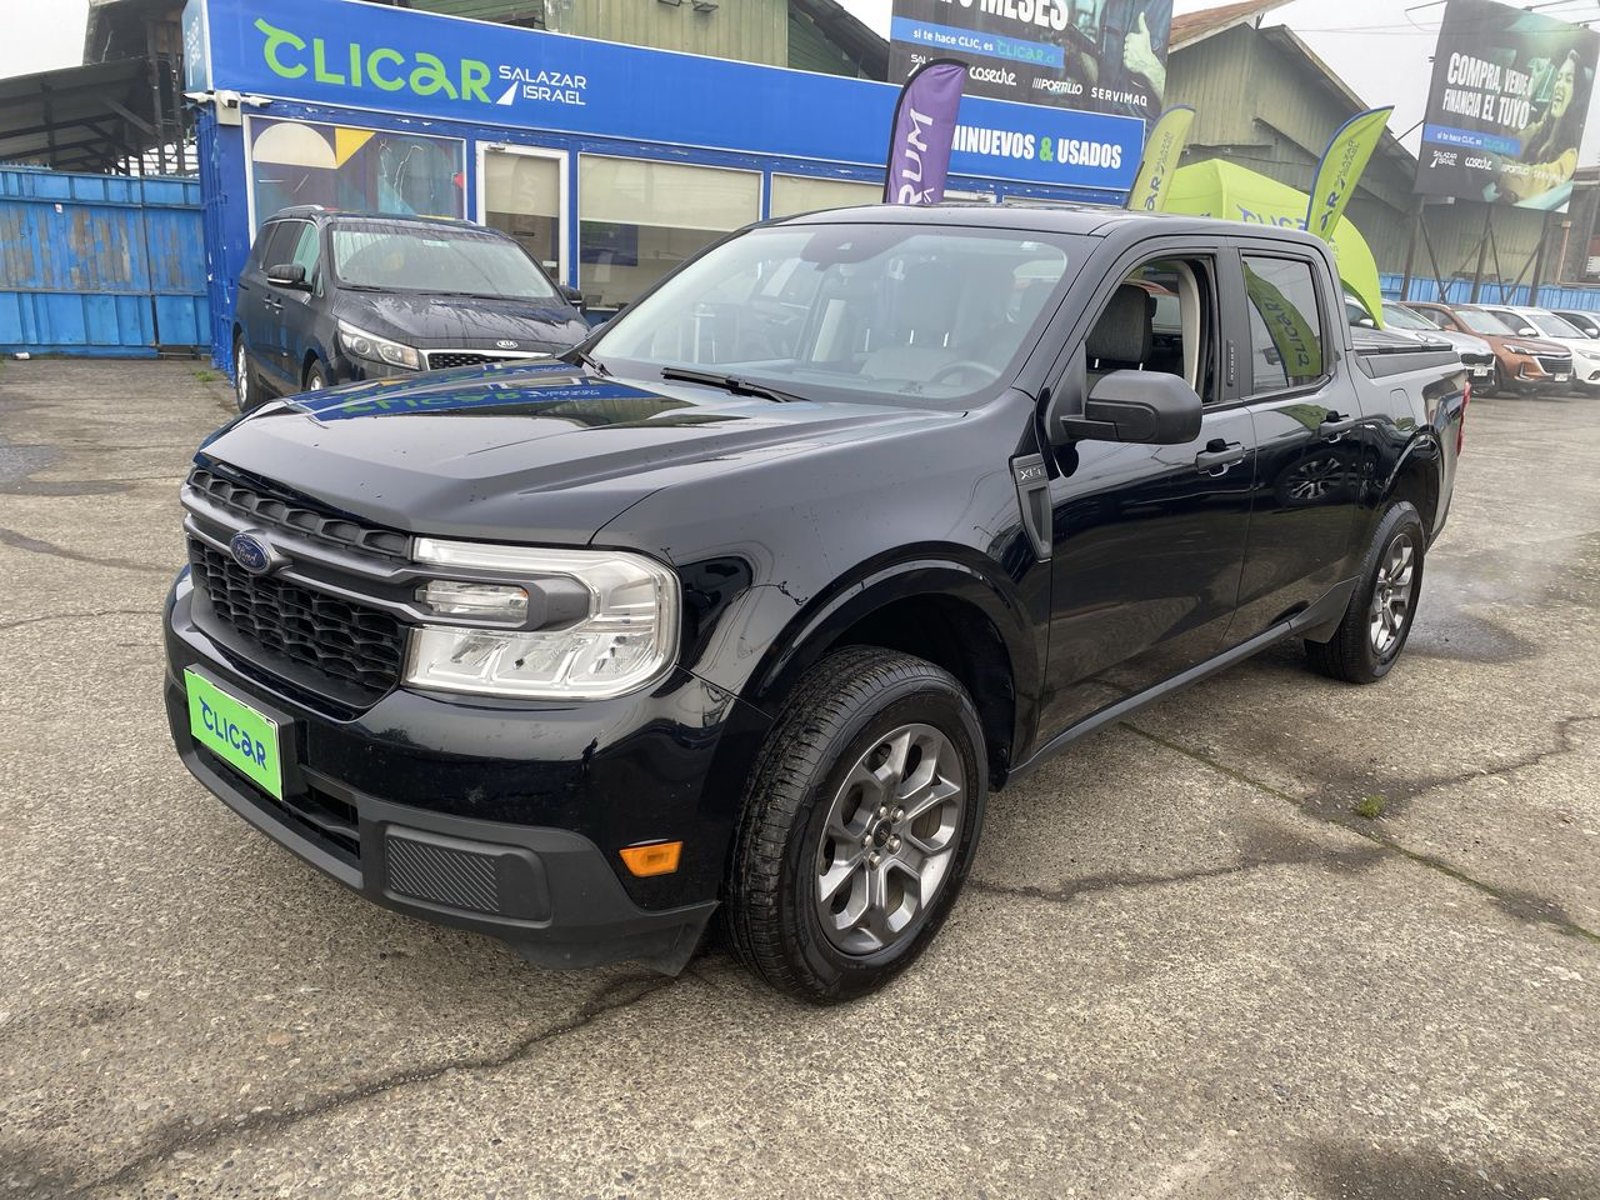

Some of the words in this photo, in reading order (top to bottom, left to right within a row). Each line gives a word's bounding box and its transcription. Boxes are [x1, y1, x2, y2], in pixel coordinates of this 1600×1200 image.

[913, 29, 921, 39] si
[923, 31, 934, 41] te
[935, 33, 957, 45] hace
[958, 37, 982, 51] CLIC,
[983, 42, 993, 51] es
[499, 65, 587, 90] SALAZAR
[1447, 51, 1503, 95] COMPRA,
[523, 84, 587, 106] ISRAEL
[1090, 87, 1148, 107] SERVIMAQ
[1482, 94, 1496, 122] EL
[1497, 95, 1531, 130] TUYO
[1039, 136, 1054, 162] &
[1057, 138, 1122, 169] USADOS
